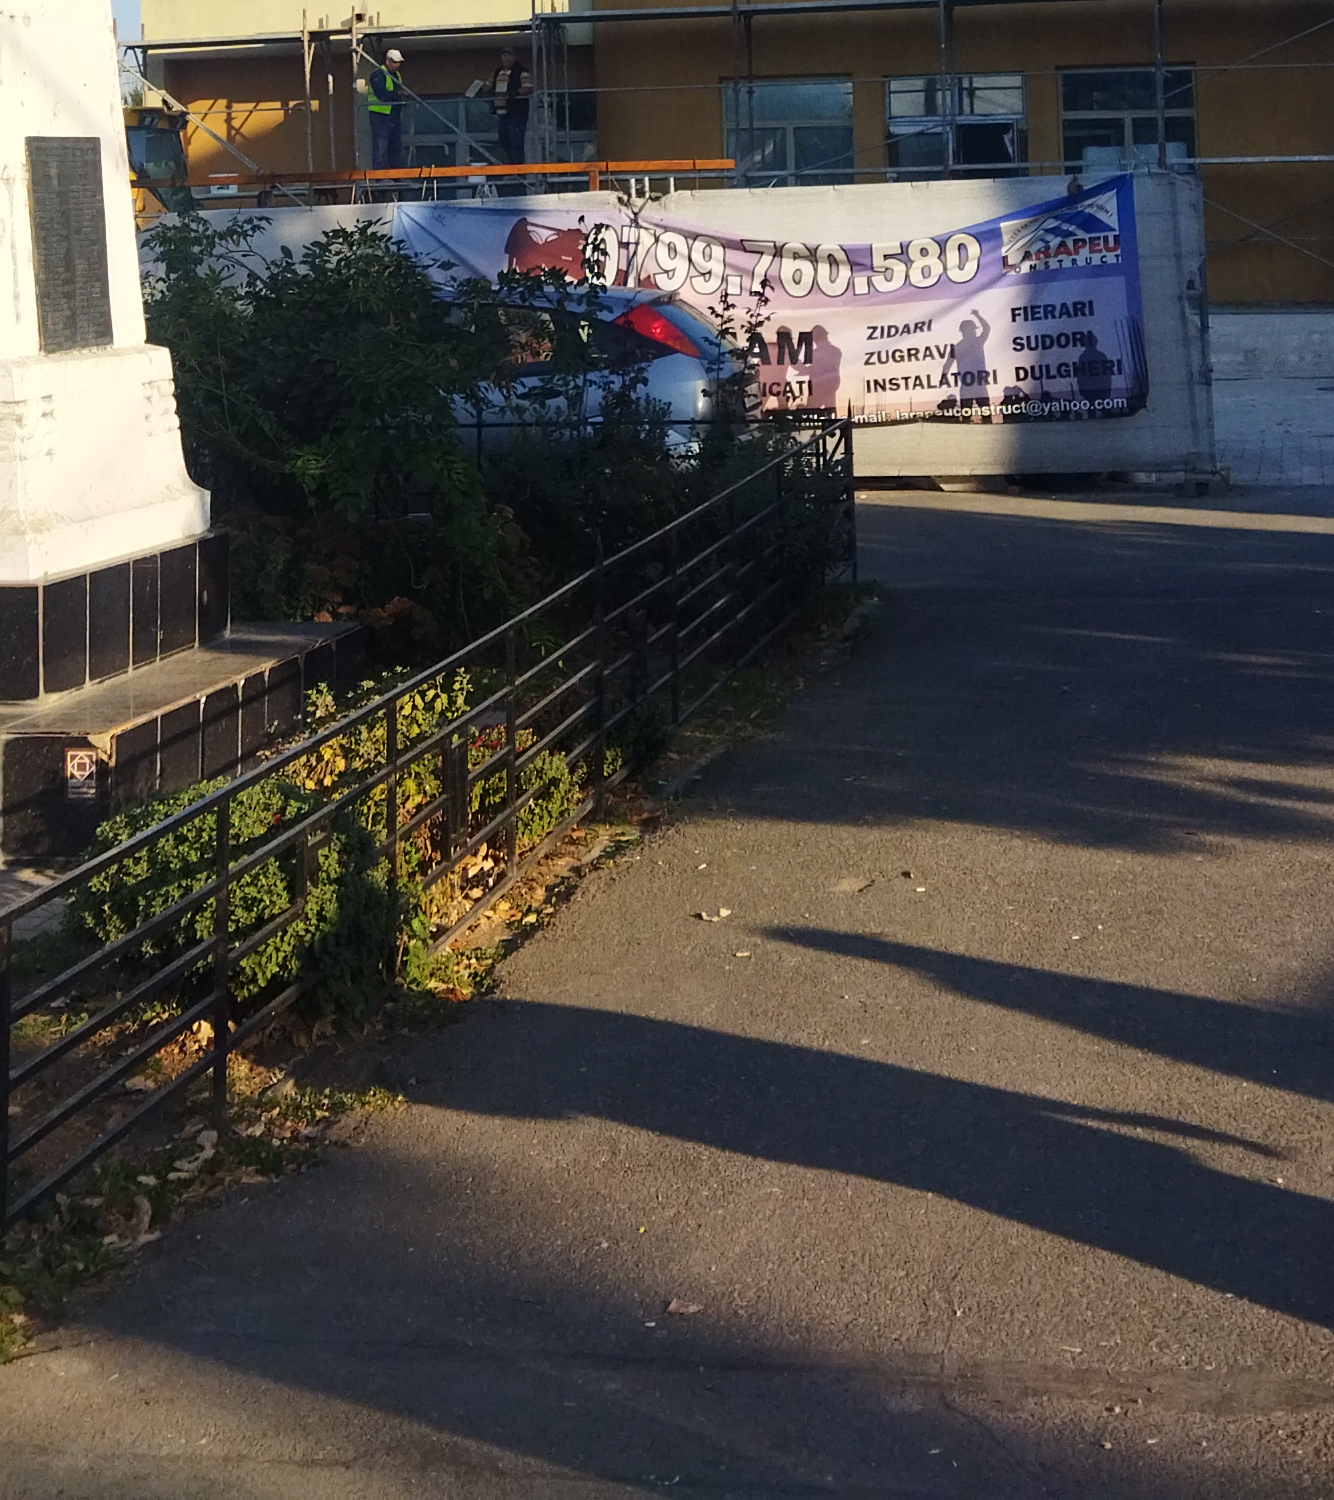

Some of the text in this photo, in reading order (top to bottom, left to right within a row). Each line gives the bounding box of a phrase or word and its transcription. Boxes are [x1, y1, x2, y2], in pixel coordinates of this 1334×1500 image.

[585, 223, 983, 298] 0799.760.580
[1002, 234, 1121, 270] LARAPEU
[1013, 254, 1122, 274] ONSTRUCT
[1011, 300, 1095, 323] FIERARI
[866, 318, 933, 341] ZIDARI
[1012, 330, 1094, 352] SUDORI
[747, 331, 814, 366] AM
[864, 343, 956, 366] ZUGRAVI
[866, 369, 998, 393] INSTALATORI
[1015, 358, 1123, 382] DULGHERI
[761, 379, 814, 398] ICATI
[895, 396, 1128, 421] larapeuconstruct@yahoo.com
